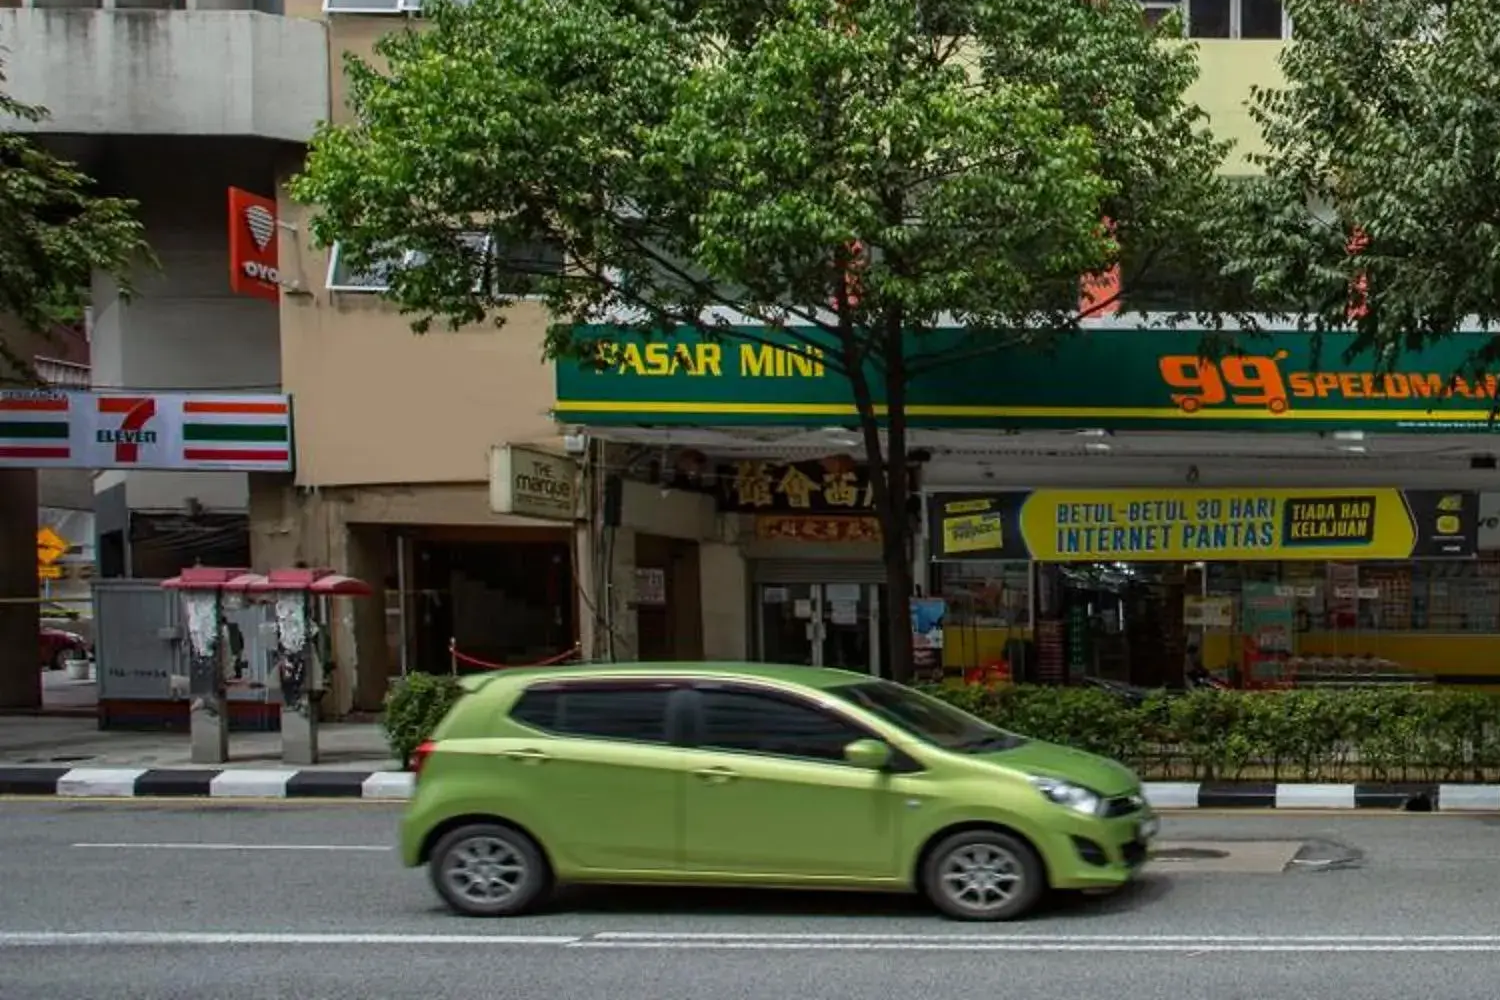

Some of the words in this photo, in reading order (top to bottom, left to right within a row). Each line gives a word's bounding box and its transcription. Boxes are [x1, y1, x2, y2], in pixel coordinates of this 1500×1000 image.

[593, 341, 722, 376] PASAR
[740, 341, 825, 377] MINI
[1159, 348, 1289, 412] 99
[98, 398, 155, 462] 7
[532, 461, 553, 475] THE
[1056, 500, 1189, 524] BETUL-BETUL
[1195, 499, 1220, 520] 30
[1229, 498, 1276, 520] HARI
[1290, 503, 1335, 521] TIADA
[1340, 501, 1370, 520] HAD
[1056, 525, 1173, 554] INTERNET
[1182, 522, 1274, 548] PANTAS
[1290, 519, 1369, 539] KELAJUAN
